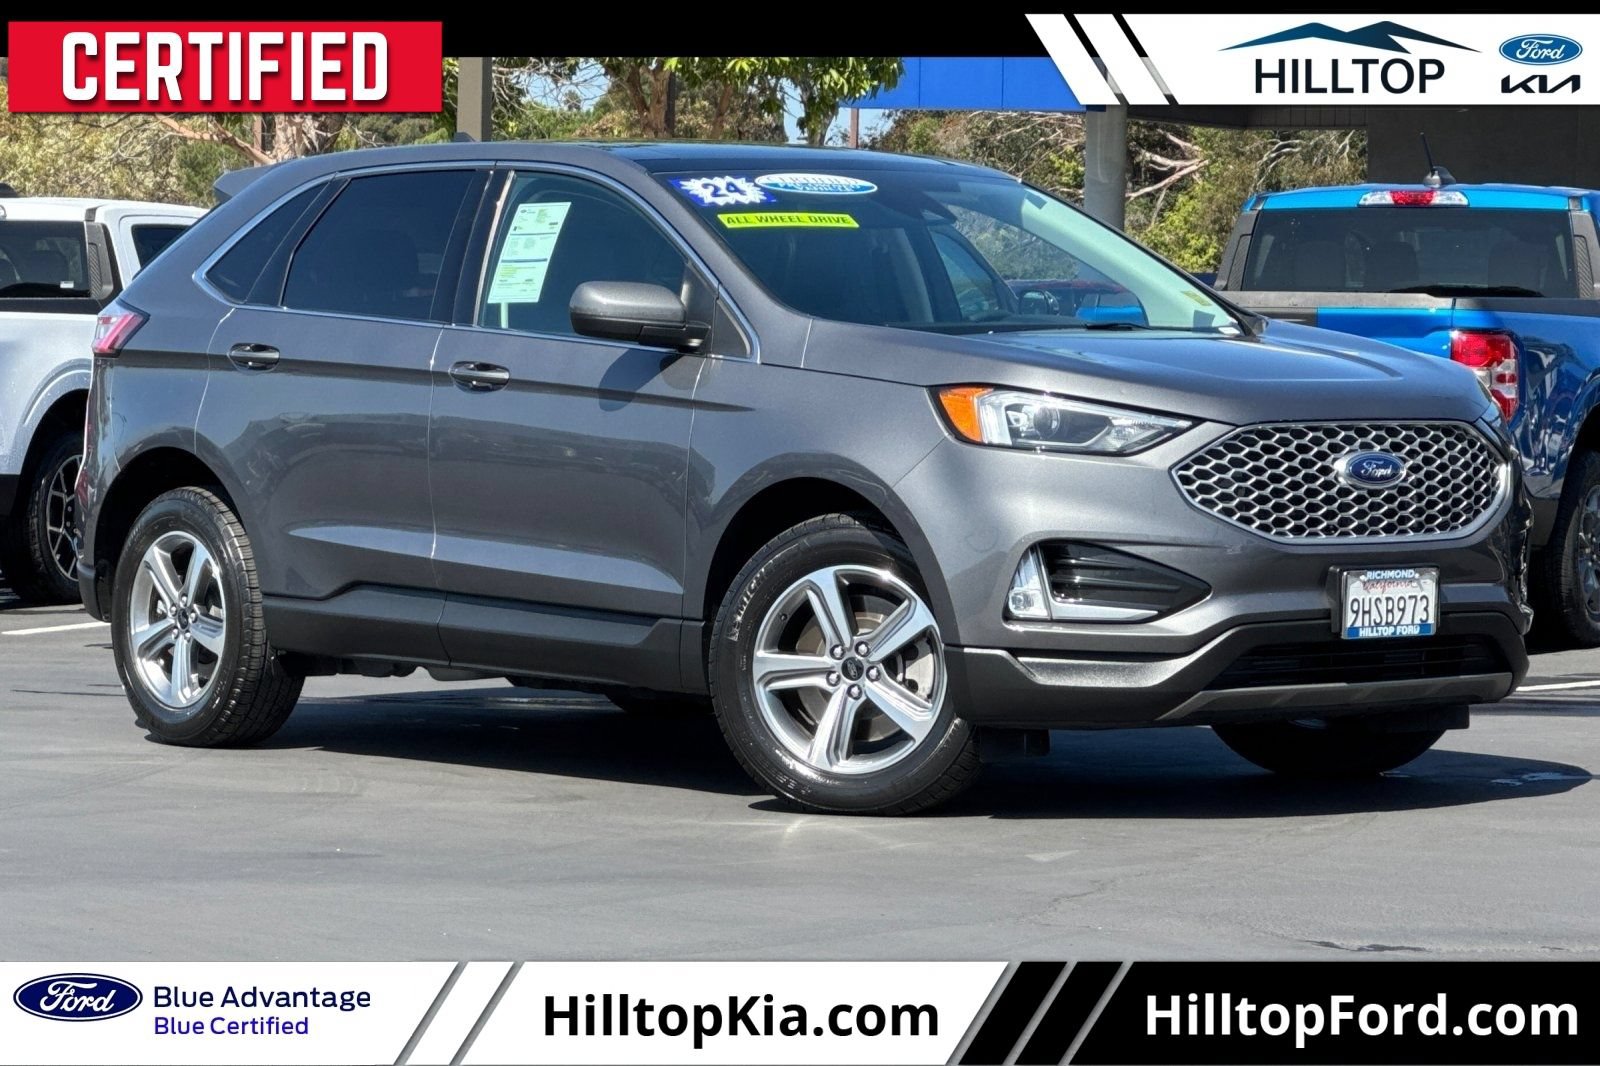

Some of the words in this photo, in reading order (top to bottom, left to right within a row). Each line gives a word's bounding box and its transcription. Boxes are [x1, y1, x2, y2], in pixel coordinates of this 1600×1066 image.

[701, 180, 748, 197] 24
[726, 216, 753, 225] ALL
[756, 215, 804, 224] WHEEL
[808, 215, 851, 225] DRIVE
[1360, 459, 1393, 478] Ford
[1365, 569, 1416, 580] RICHMOND
[1349, 595, 1430, 628] 9HSB973
[1360, 625, 1396, 637] HILLTOP
[1396, 624, 1421, 635] FORD
